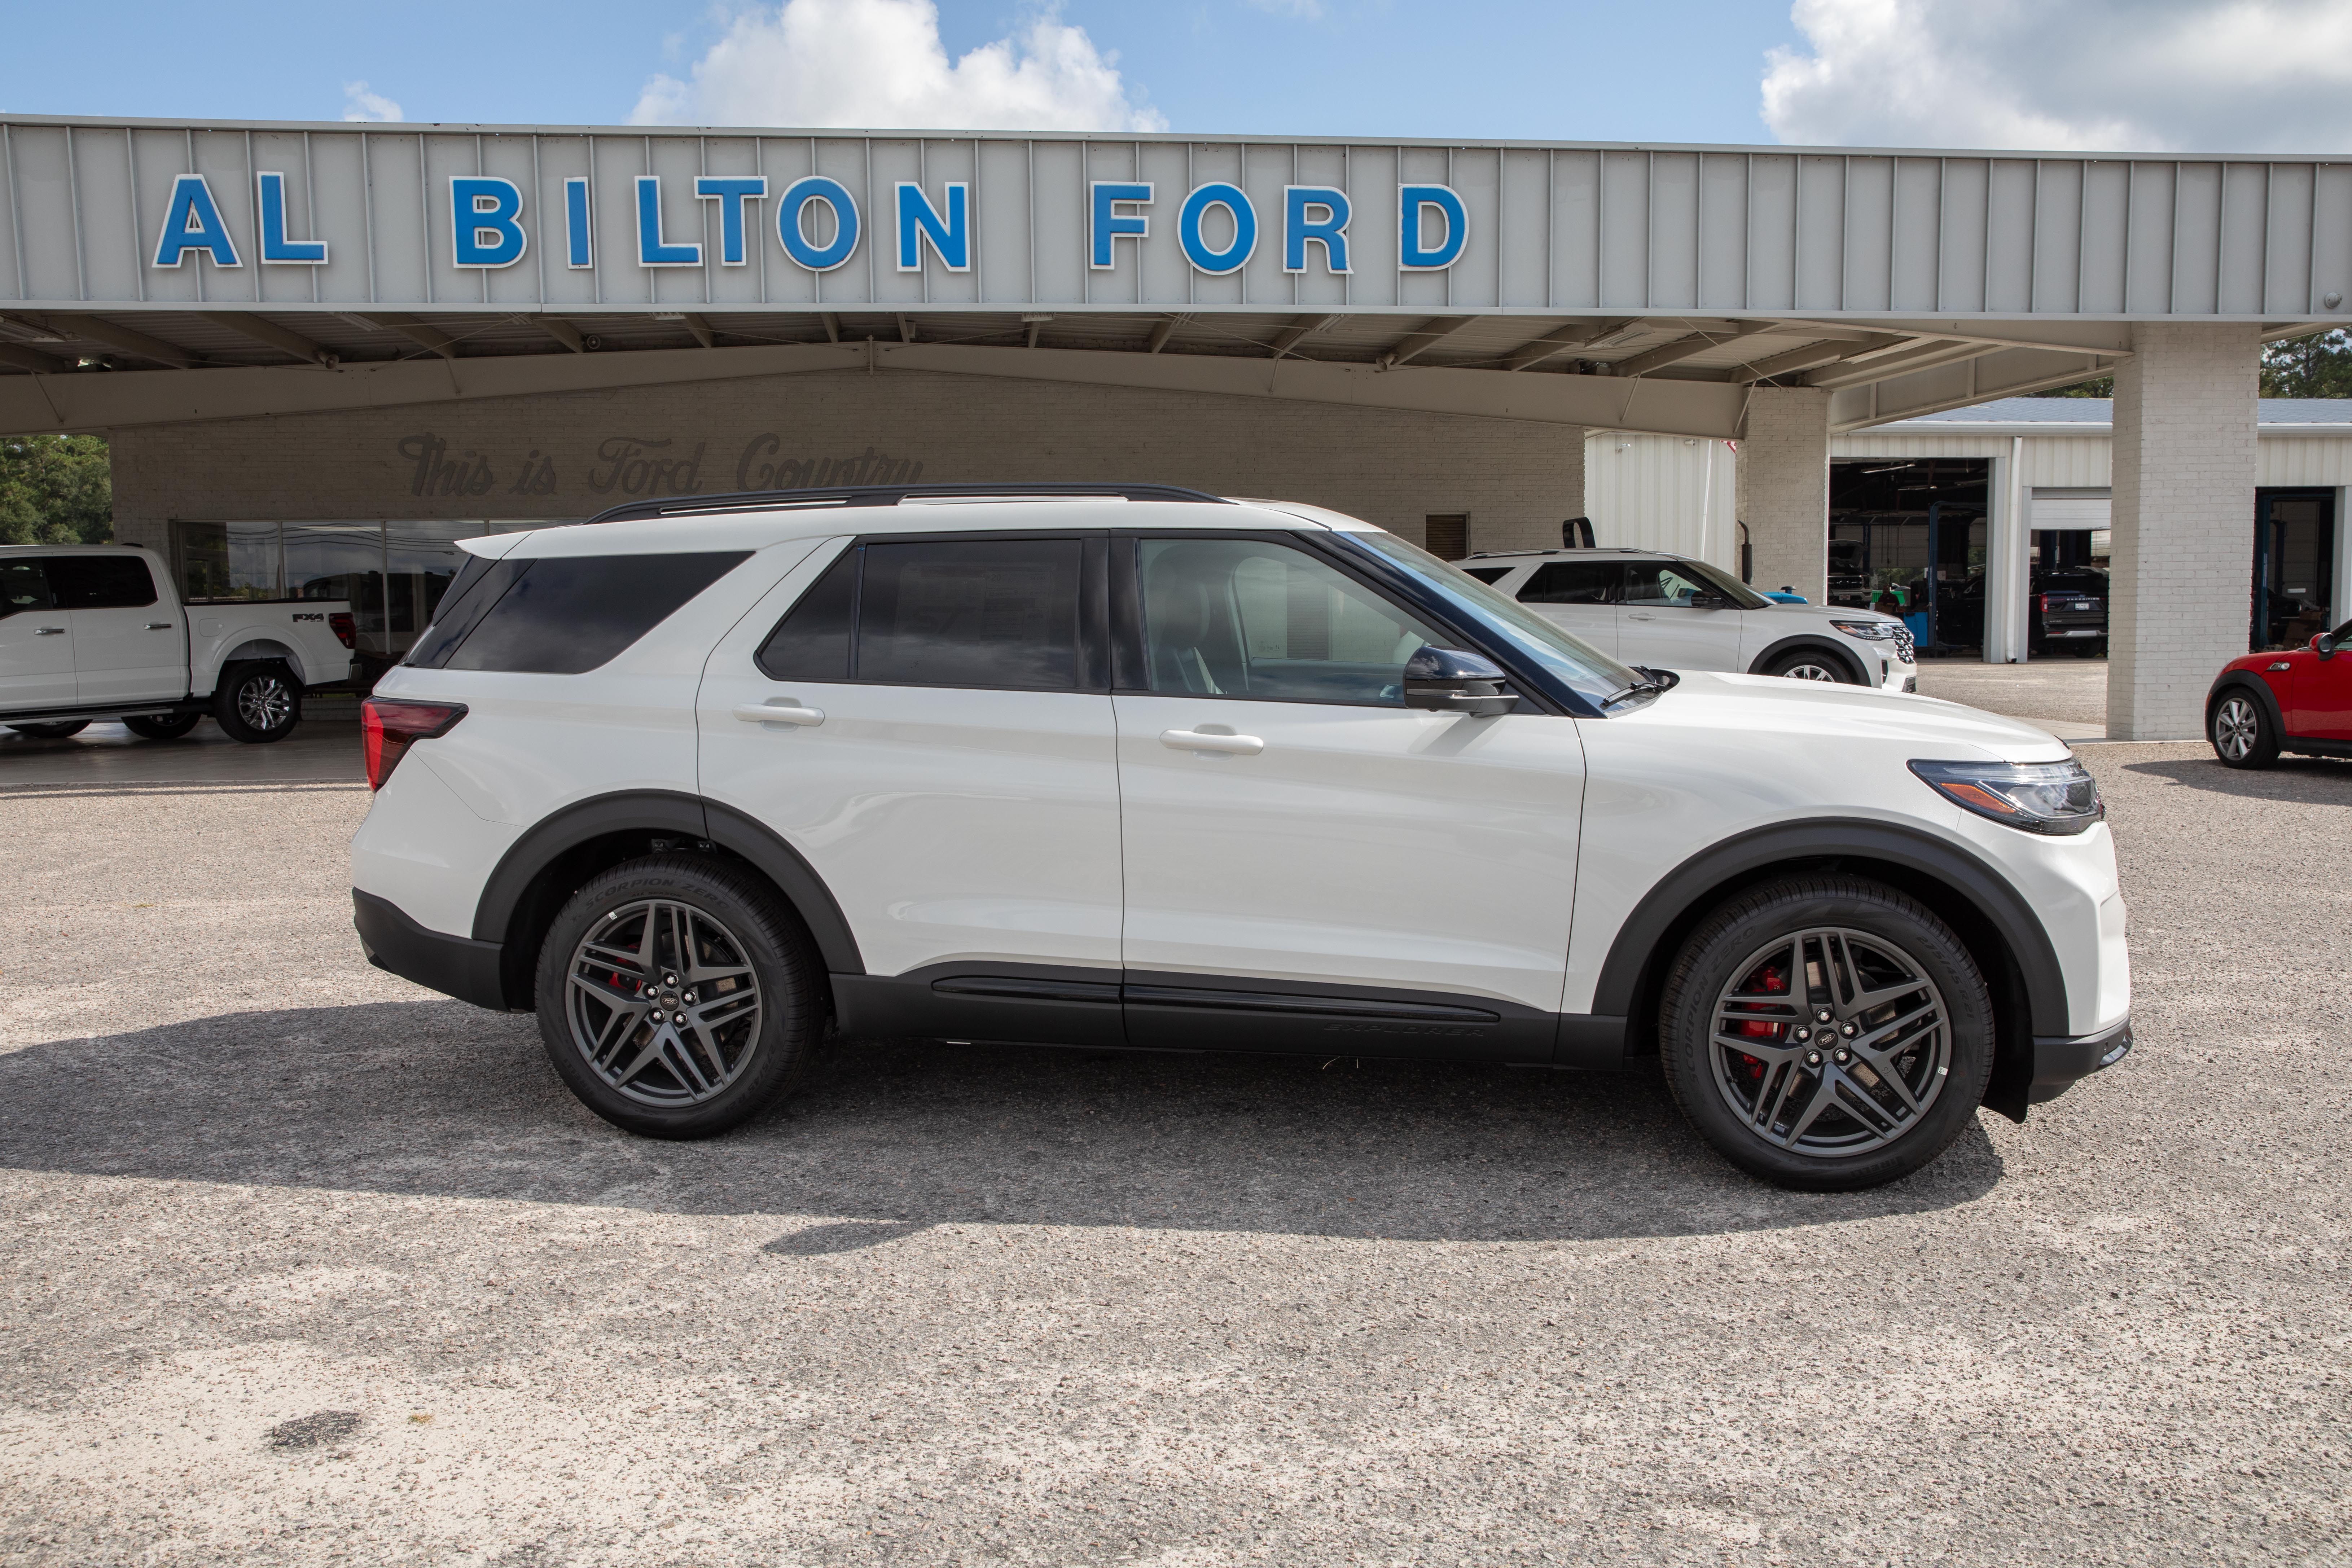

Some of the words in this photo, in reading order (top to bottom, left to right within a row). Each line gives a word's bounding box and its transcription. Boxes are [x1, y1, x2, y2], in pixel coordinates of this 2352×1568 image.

[152, 171, 328, 268] AL
[449, 175, 971, 272] BILTON
[1089, 181, 1470, 276] FORD
[398, 432, 495, 496] This
[508, 449, 557, 496] is
[588, 436, 705, 495] Ford
[737, 432, 923, 493] Country
[292, 613, 324, 622] FX4
[585, 878, 676, 910] SCORPION
[680, 884, 730, 909] ZERO
[1916, 936, 1963, 984] 275/45
[1959, 989, 1975, 1019] R21
[1323, 1023, 1485, 1036] EXPLORER
[1685, 975, 1709, 1086] SCORPION
[1711, 926, 1756, 974] ZERO
[1821, 1034, 1832, 1044] Ford
